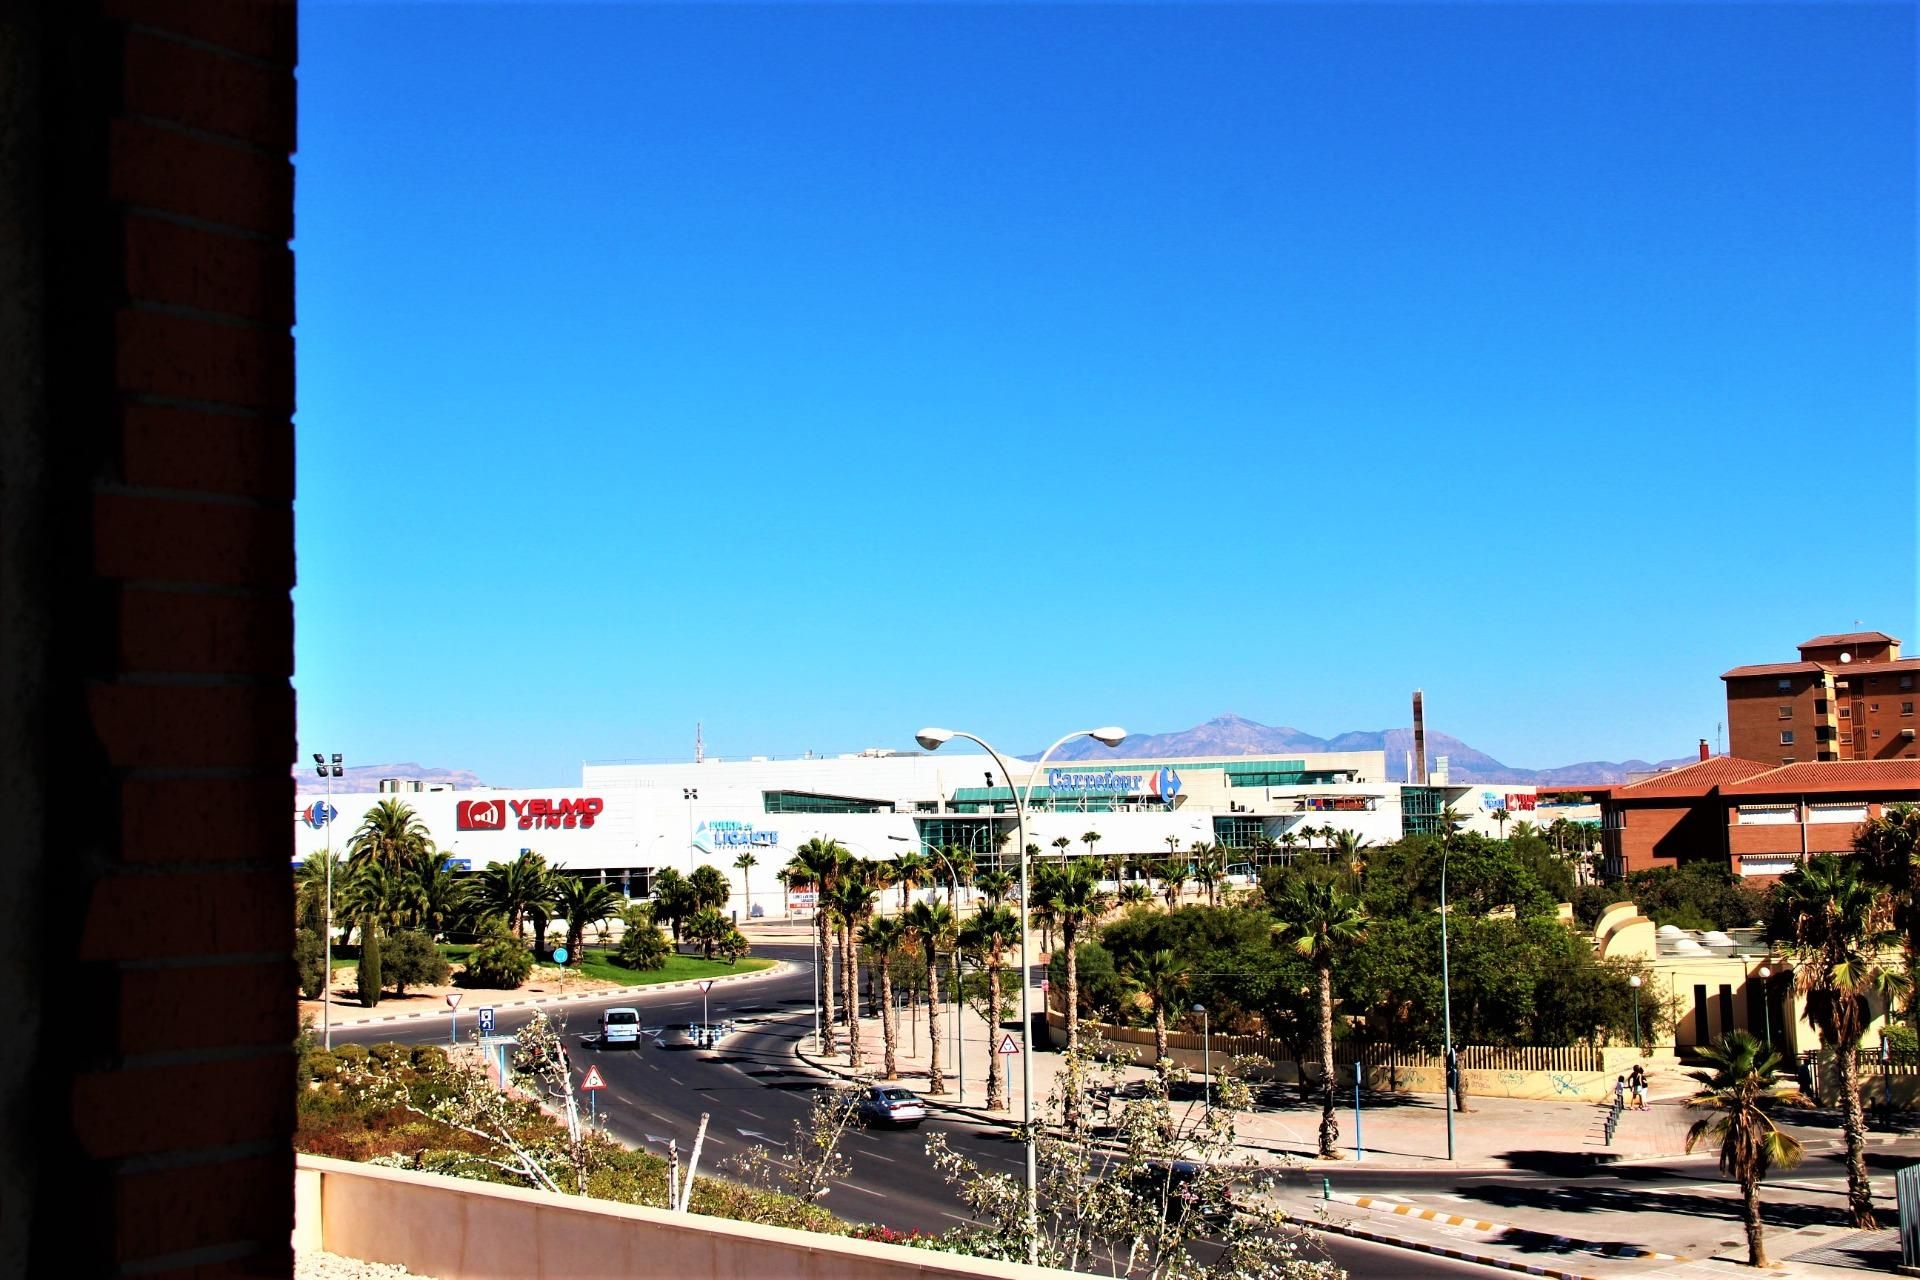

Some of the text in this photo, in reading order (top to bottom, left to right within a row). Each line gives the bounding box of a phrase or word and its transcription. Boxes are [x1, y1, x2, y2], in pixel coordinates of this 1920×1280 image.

[1048, 767, 1143, 792] Carrefour
[509, 798, 603, 816] YELMO
[518, 814, 595, 830] CINES
